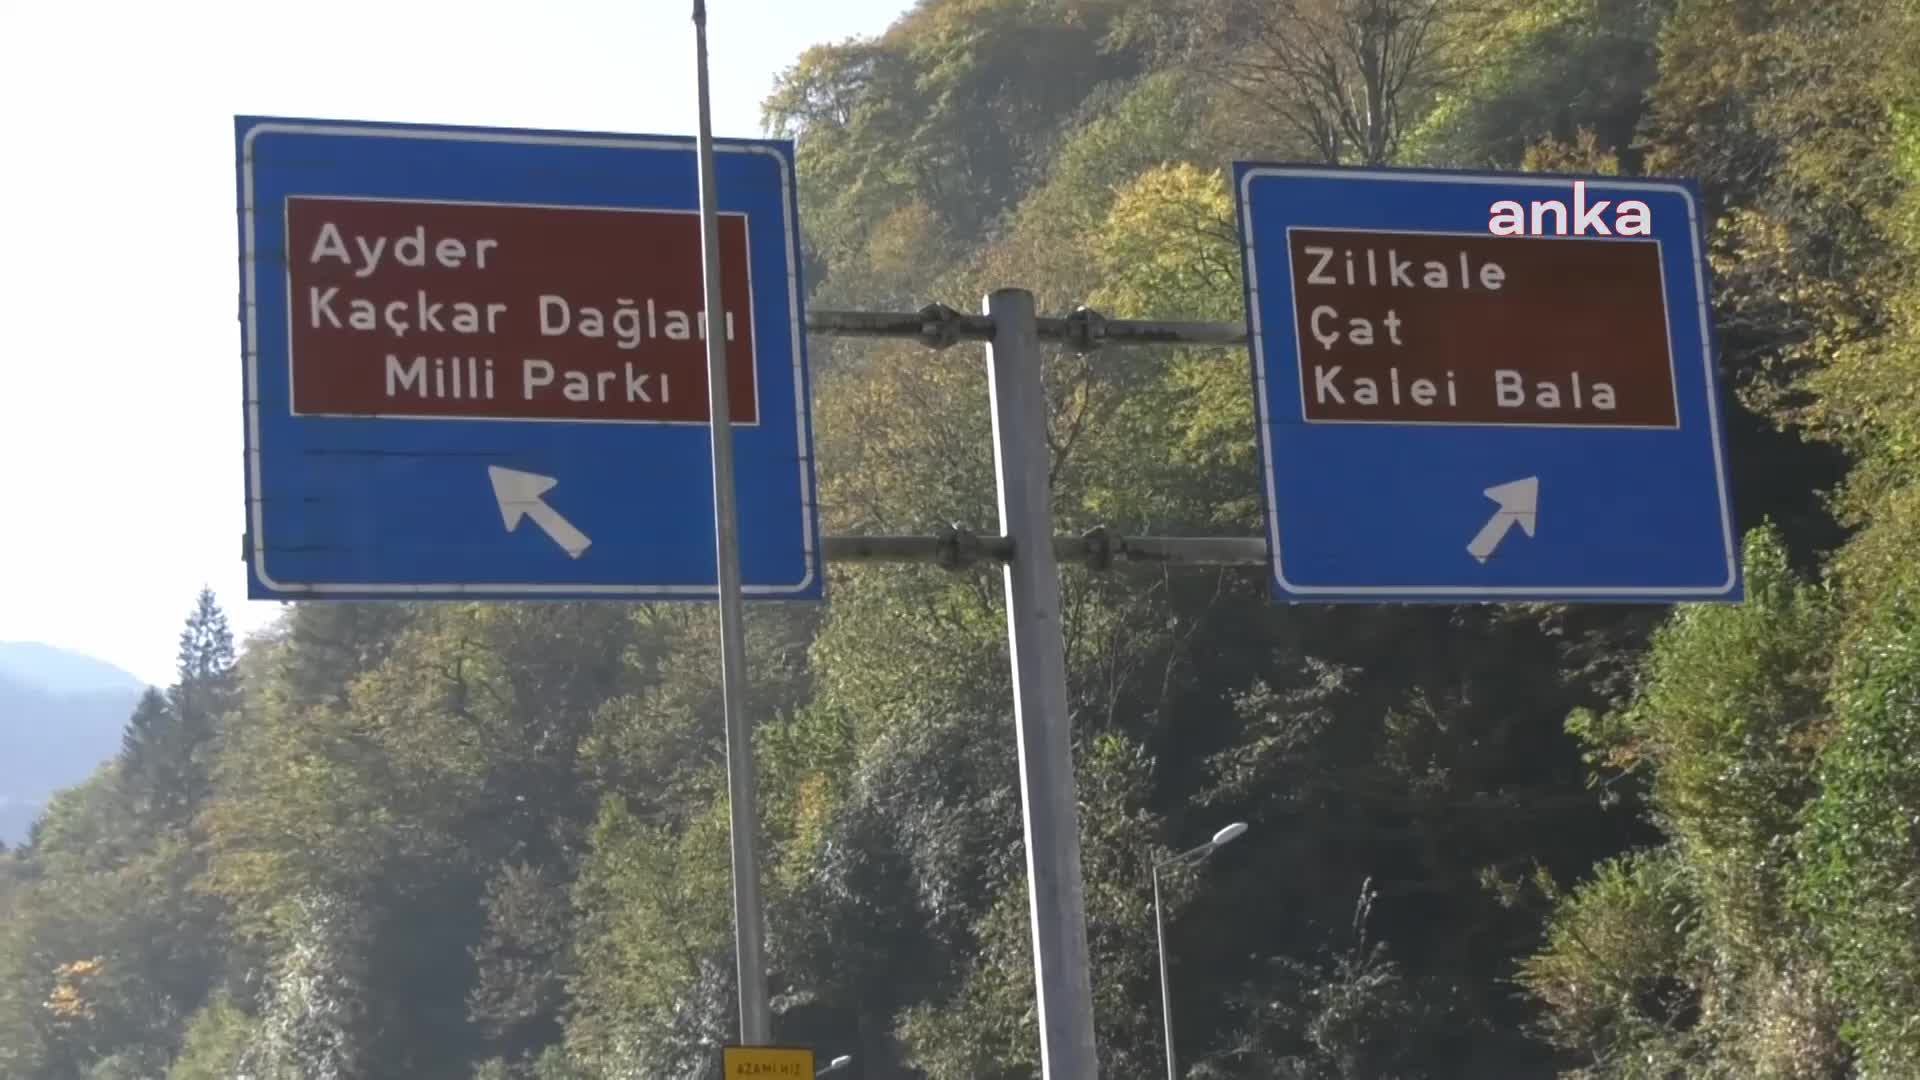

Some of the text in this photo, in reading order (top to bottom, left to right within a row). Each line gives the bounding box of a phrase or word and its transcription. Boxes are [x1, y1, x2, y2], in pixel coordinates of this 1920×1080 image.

[310, 222, 498, 277] Ayder
[1305, 248, 1506, 290] Zilkale
[309, 287, 507, 337] Kaçkar
[1310, 306, 1404, 349] Çat
[386, 356, 670, 403] Milli Parkı
[1315, 367, 1617, 411] Kalei Bala
